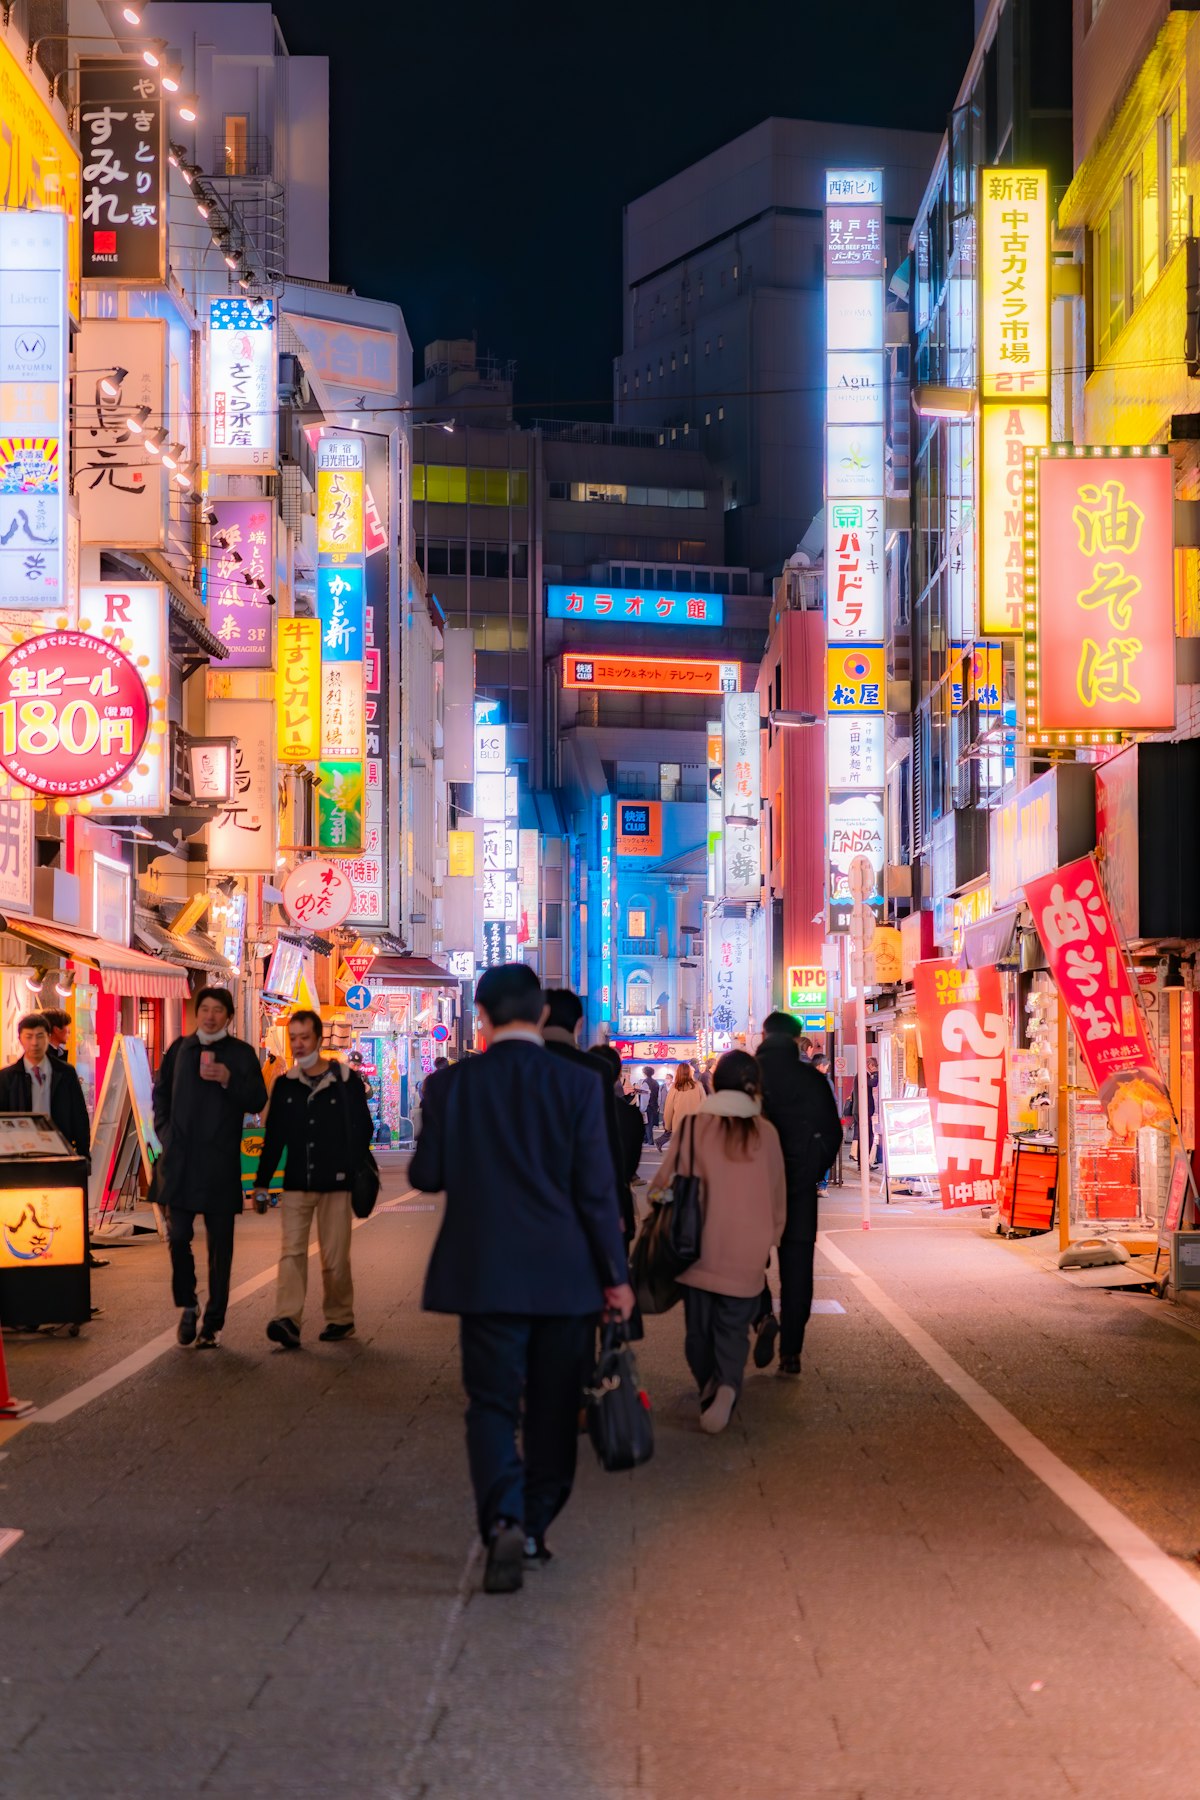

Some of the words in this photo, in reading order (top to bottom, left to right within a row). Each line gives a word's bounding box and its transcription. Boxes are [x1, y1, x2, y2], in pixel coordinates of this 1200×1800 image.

[132, 78, 158, 227] やきとり家
[82, 106, 130, 226] すみれ
[828, 180, 879, 196] 西新ビル
[988, 177, 1039, 201] 新宿
[829, 219, 880, 232] 神戸牛
[829, 232, 879, 245] ステーキ
[91, 253, 119, 263] SMILE
[1000, 208, 1031, 364] 中古カメラ市場
[995, 371, 1036, 393] 2F
[228, 362, 253, 447] さくら水産
[252, 452, 270, 464] 5F
[328, 473, 353, 542] よりみち
[865, 507, 880, 575] ステーキ
[331, 553, 348, 563] 3F
[832, 532, 864, 627] パンドラ
[1071, 479, 1146, 708] 油そば
[323, 574, 357, 656] かど新
[565, 592, 707, 620] カラオケ館
[247, 628, 267, 641] 3F
[844, 629, 868, 638] 2F
[8, 665, 120, 698] 生ビール
[283, 622, 314, 742] 牛すじカレー
[831, 683, 881, 706] 松屋
[103, 705, 134, 718] (税別)
[480, 738, 500, 749] KC
[849, 721, 861, 783] 三田製麺所
[624, 810, 646, 822] 快活
[624, 822, 647, 832] CLUB
[832, 828, 882, 843] PANDA
[831, 841, 874, 853] LINDA
[316, 867, 342, 917] わんたん
[294, 892, 316, 923] めん
[792, 969, 826, 988] NPC
[797, 991, 822, 1003] 24H
